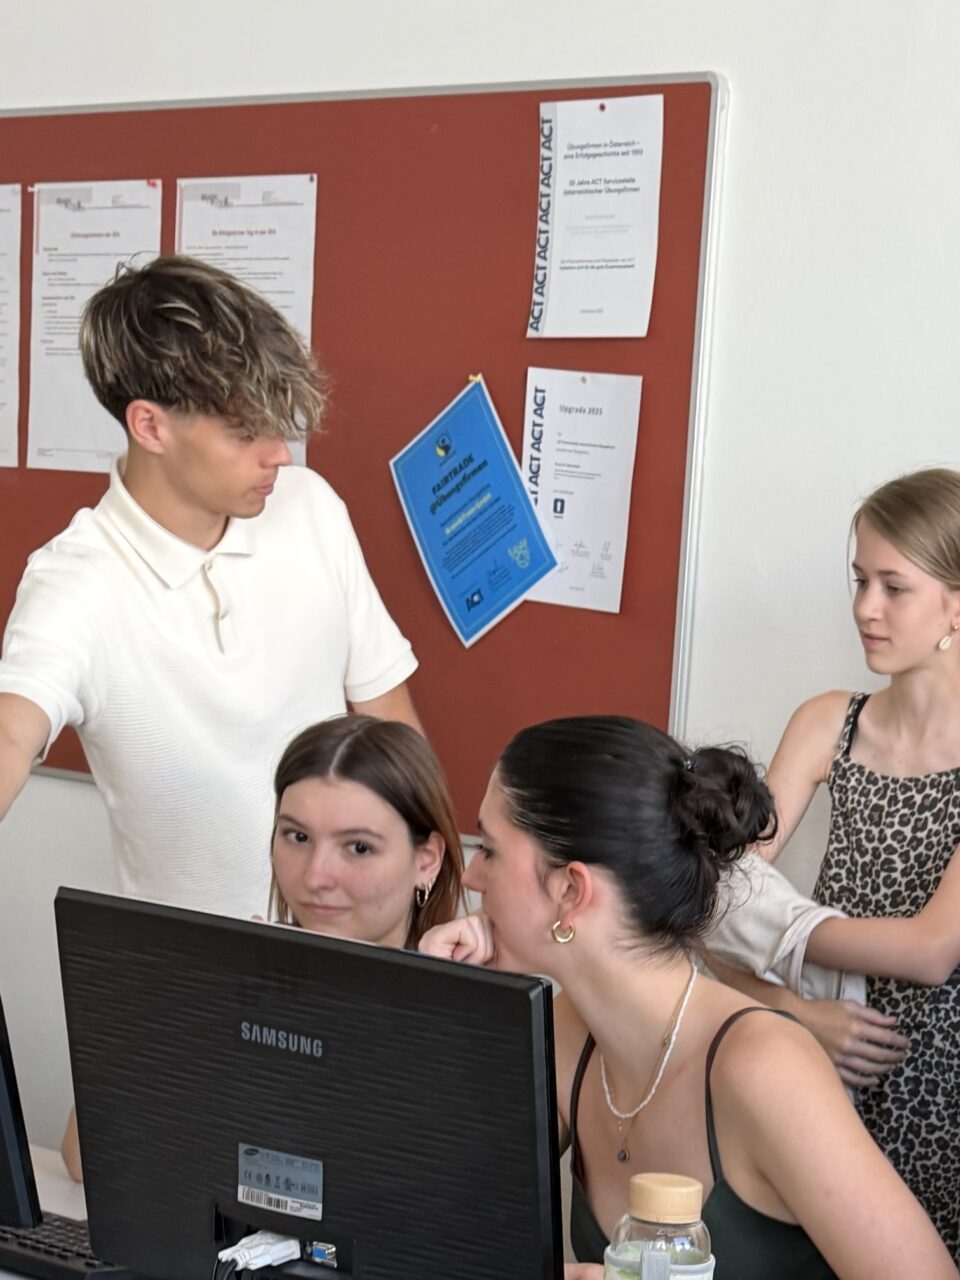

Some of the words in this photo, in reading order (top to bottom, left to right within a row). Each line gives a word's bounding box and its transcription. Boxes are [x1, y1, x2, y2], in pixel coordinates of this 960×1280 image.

[541, 118, 553, 152] ACT
[540, 156, 552, 188] ACT
[539, 191, 550, 225] ACT
[537, 228, 549, 261] ACT
[534, 264, 547, 297] ACT
[529, 300, 544, 332] ACT
[533, 386, 546, 419] ACT
[560, 404, 586, 415] Upgrade
[531, 420, 544, 453] ACT
[432, 453, 475, 495] FAIRTRADE
[528, 454, 541, 487] ACT
[241, 1021, 323, 1058] SAMSUNG
